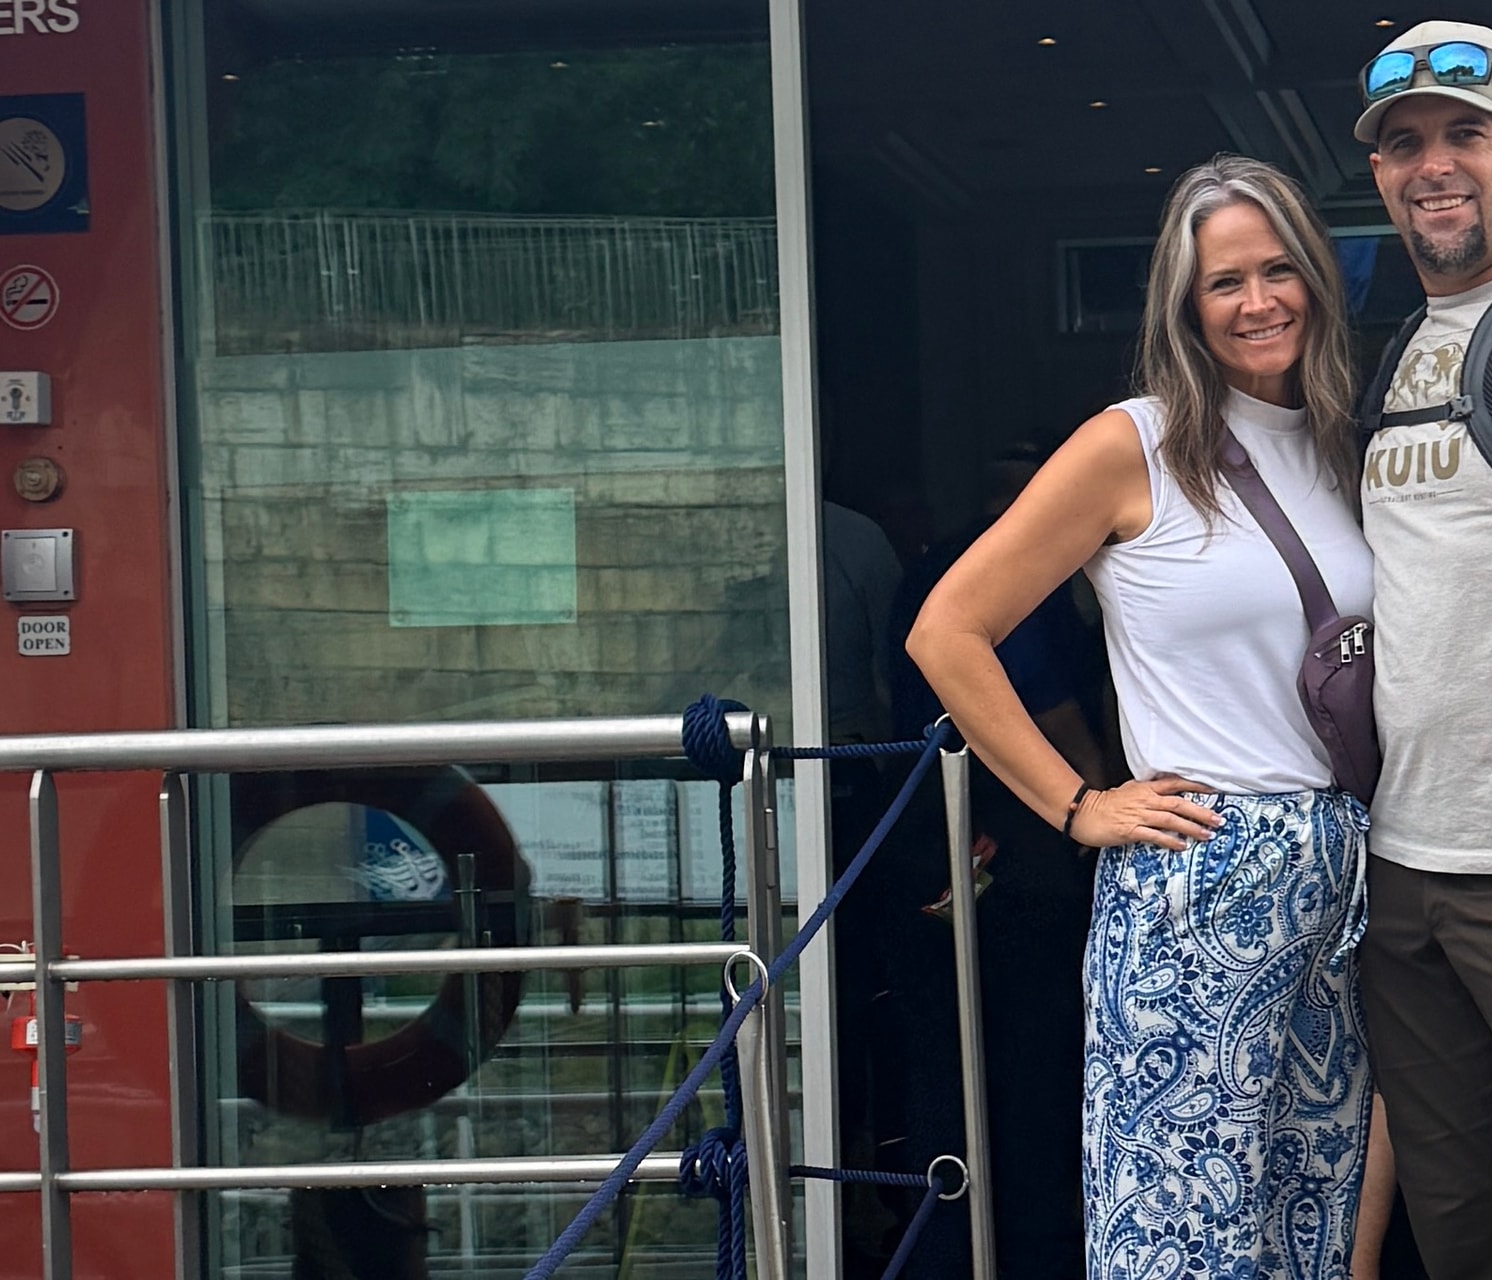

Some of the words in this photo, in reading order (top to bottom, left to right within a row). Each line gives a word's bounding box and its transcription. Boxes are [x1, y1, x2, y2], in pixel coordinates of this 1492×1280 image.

[1366, 437, 1461, 491] KUIU
[21, 621, 67, 634] DOOR
[23, 637, 66, 650] OPEN
